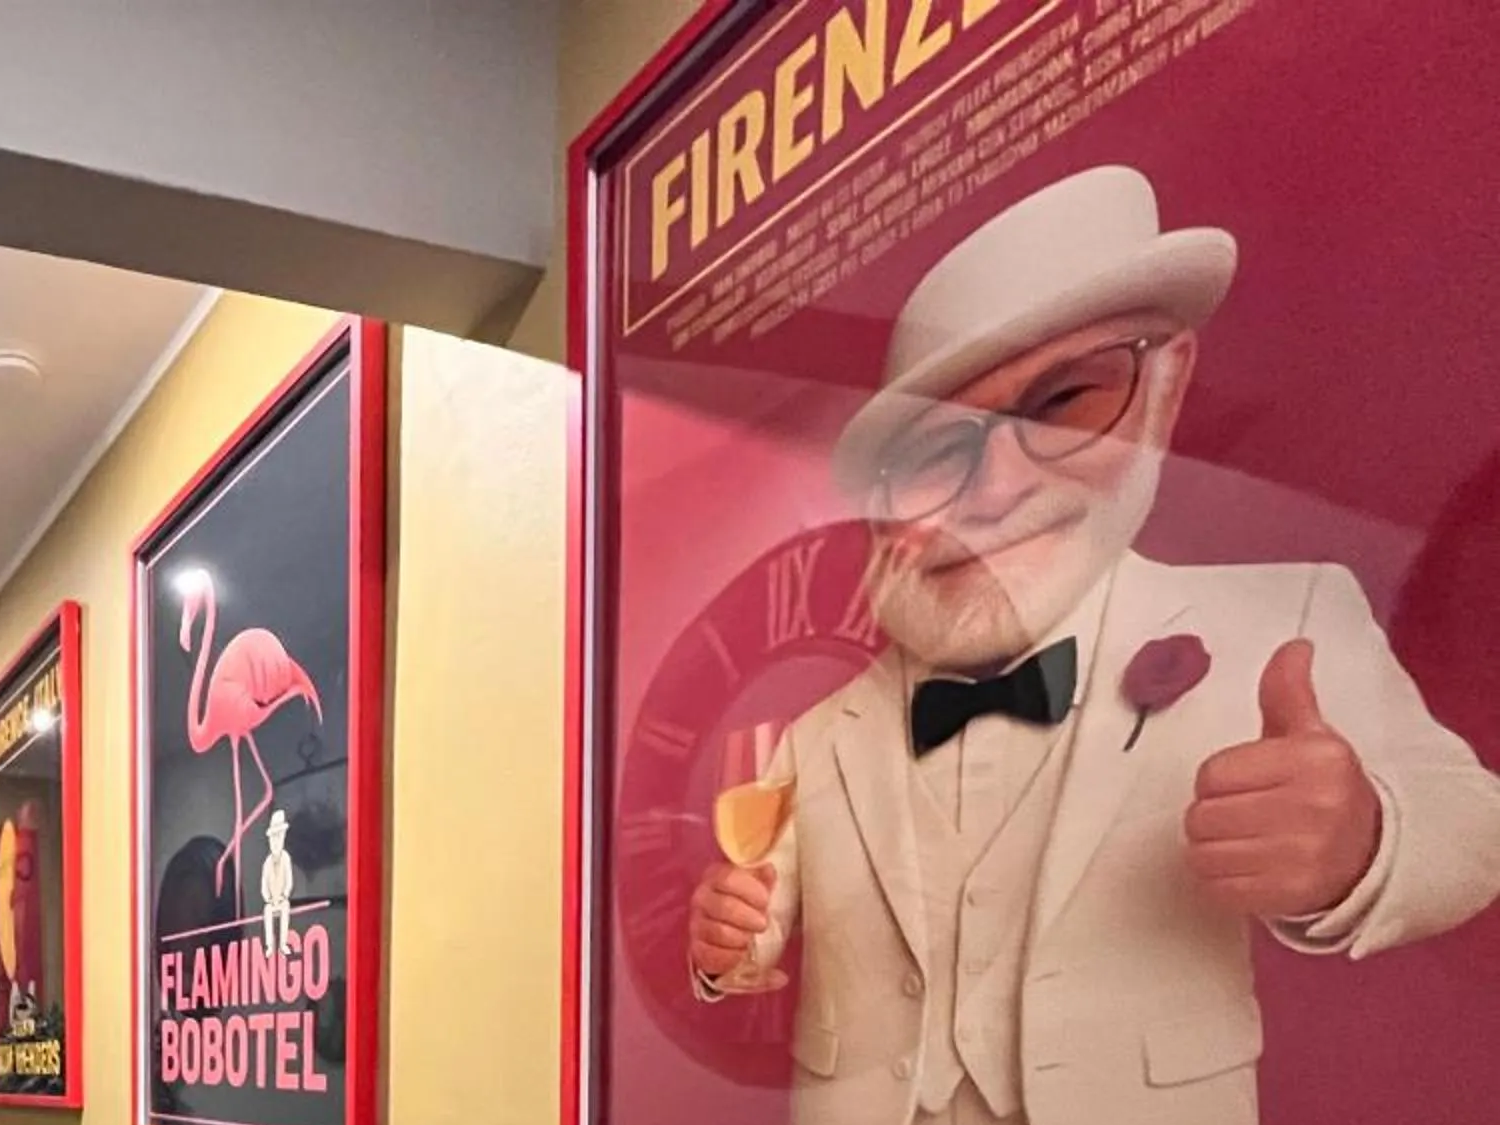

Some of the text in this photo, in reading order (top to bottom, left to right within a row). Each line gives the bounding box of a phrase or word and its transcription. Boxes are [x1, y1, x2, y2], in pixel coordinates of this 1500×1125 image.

[651, 0, 1012, 282] FIRENZ
[161, 924, 330, 1013] FLAMINGO
[161, 1010, 328, 1092] BOBOTEL
